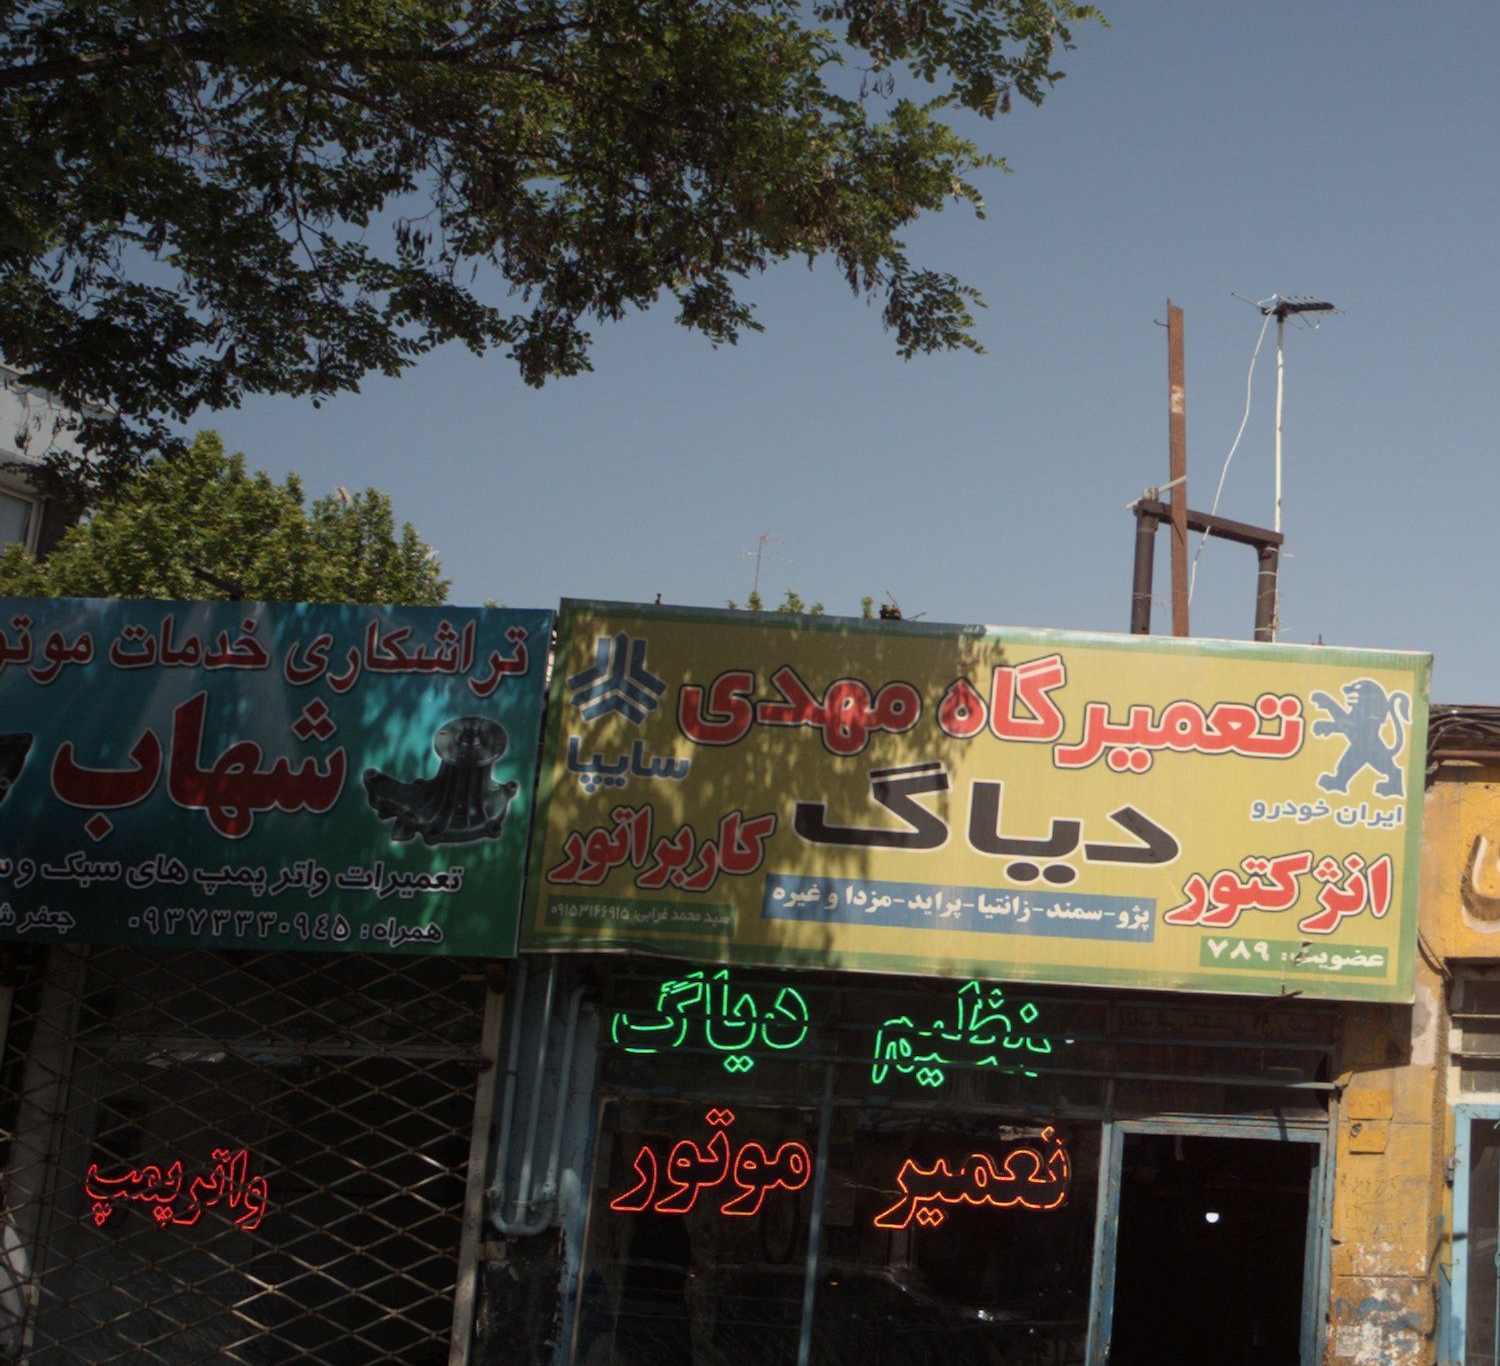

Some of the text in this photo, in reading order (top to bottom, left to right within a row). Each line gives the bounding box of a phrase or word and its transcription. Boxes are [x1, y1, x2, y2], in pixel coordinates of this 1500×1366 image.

[0, 613, 529, 697] تراشکاری خدمات موت
[677, 653, 1305, 773] تعمیرگاه مهدی
[51, 690, 347, 840] شهاب
[567, 735, 691, 795] سایپا
[794, 762, 1181, 886] دیاگ
[1250, 799, 1403, 827] ایران خودرو
[546, 804, 777, 892] کاربراتور
[15, 857, 36, 889] و
[41, 851, 121, 888] سبک
[126, 853, 189, 889] های
[194, 864, 266, 897] پمپ
[268, 859, 329, 897] واتر
[336, 860, 463, 899] تعمیرات
[772, 882, 822, 908] غیره
[825, 889, 837, 910] و
[1163, 850, 1394, 935] انژکتور
[17, 906, 76, 934] جعفر
[671, 911, 701, 923] محمد
[704, 912, 730, 926] سید
[1207, 938, 1270, 962] ۷۸۹
[612, 969, 808, 1073] دیاگ
[610, 1108, 811, 1215] موتور
